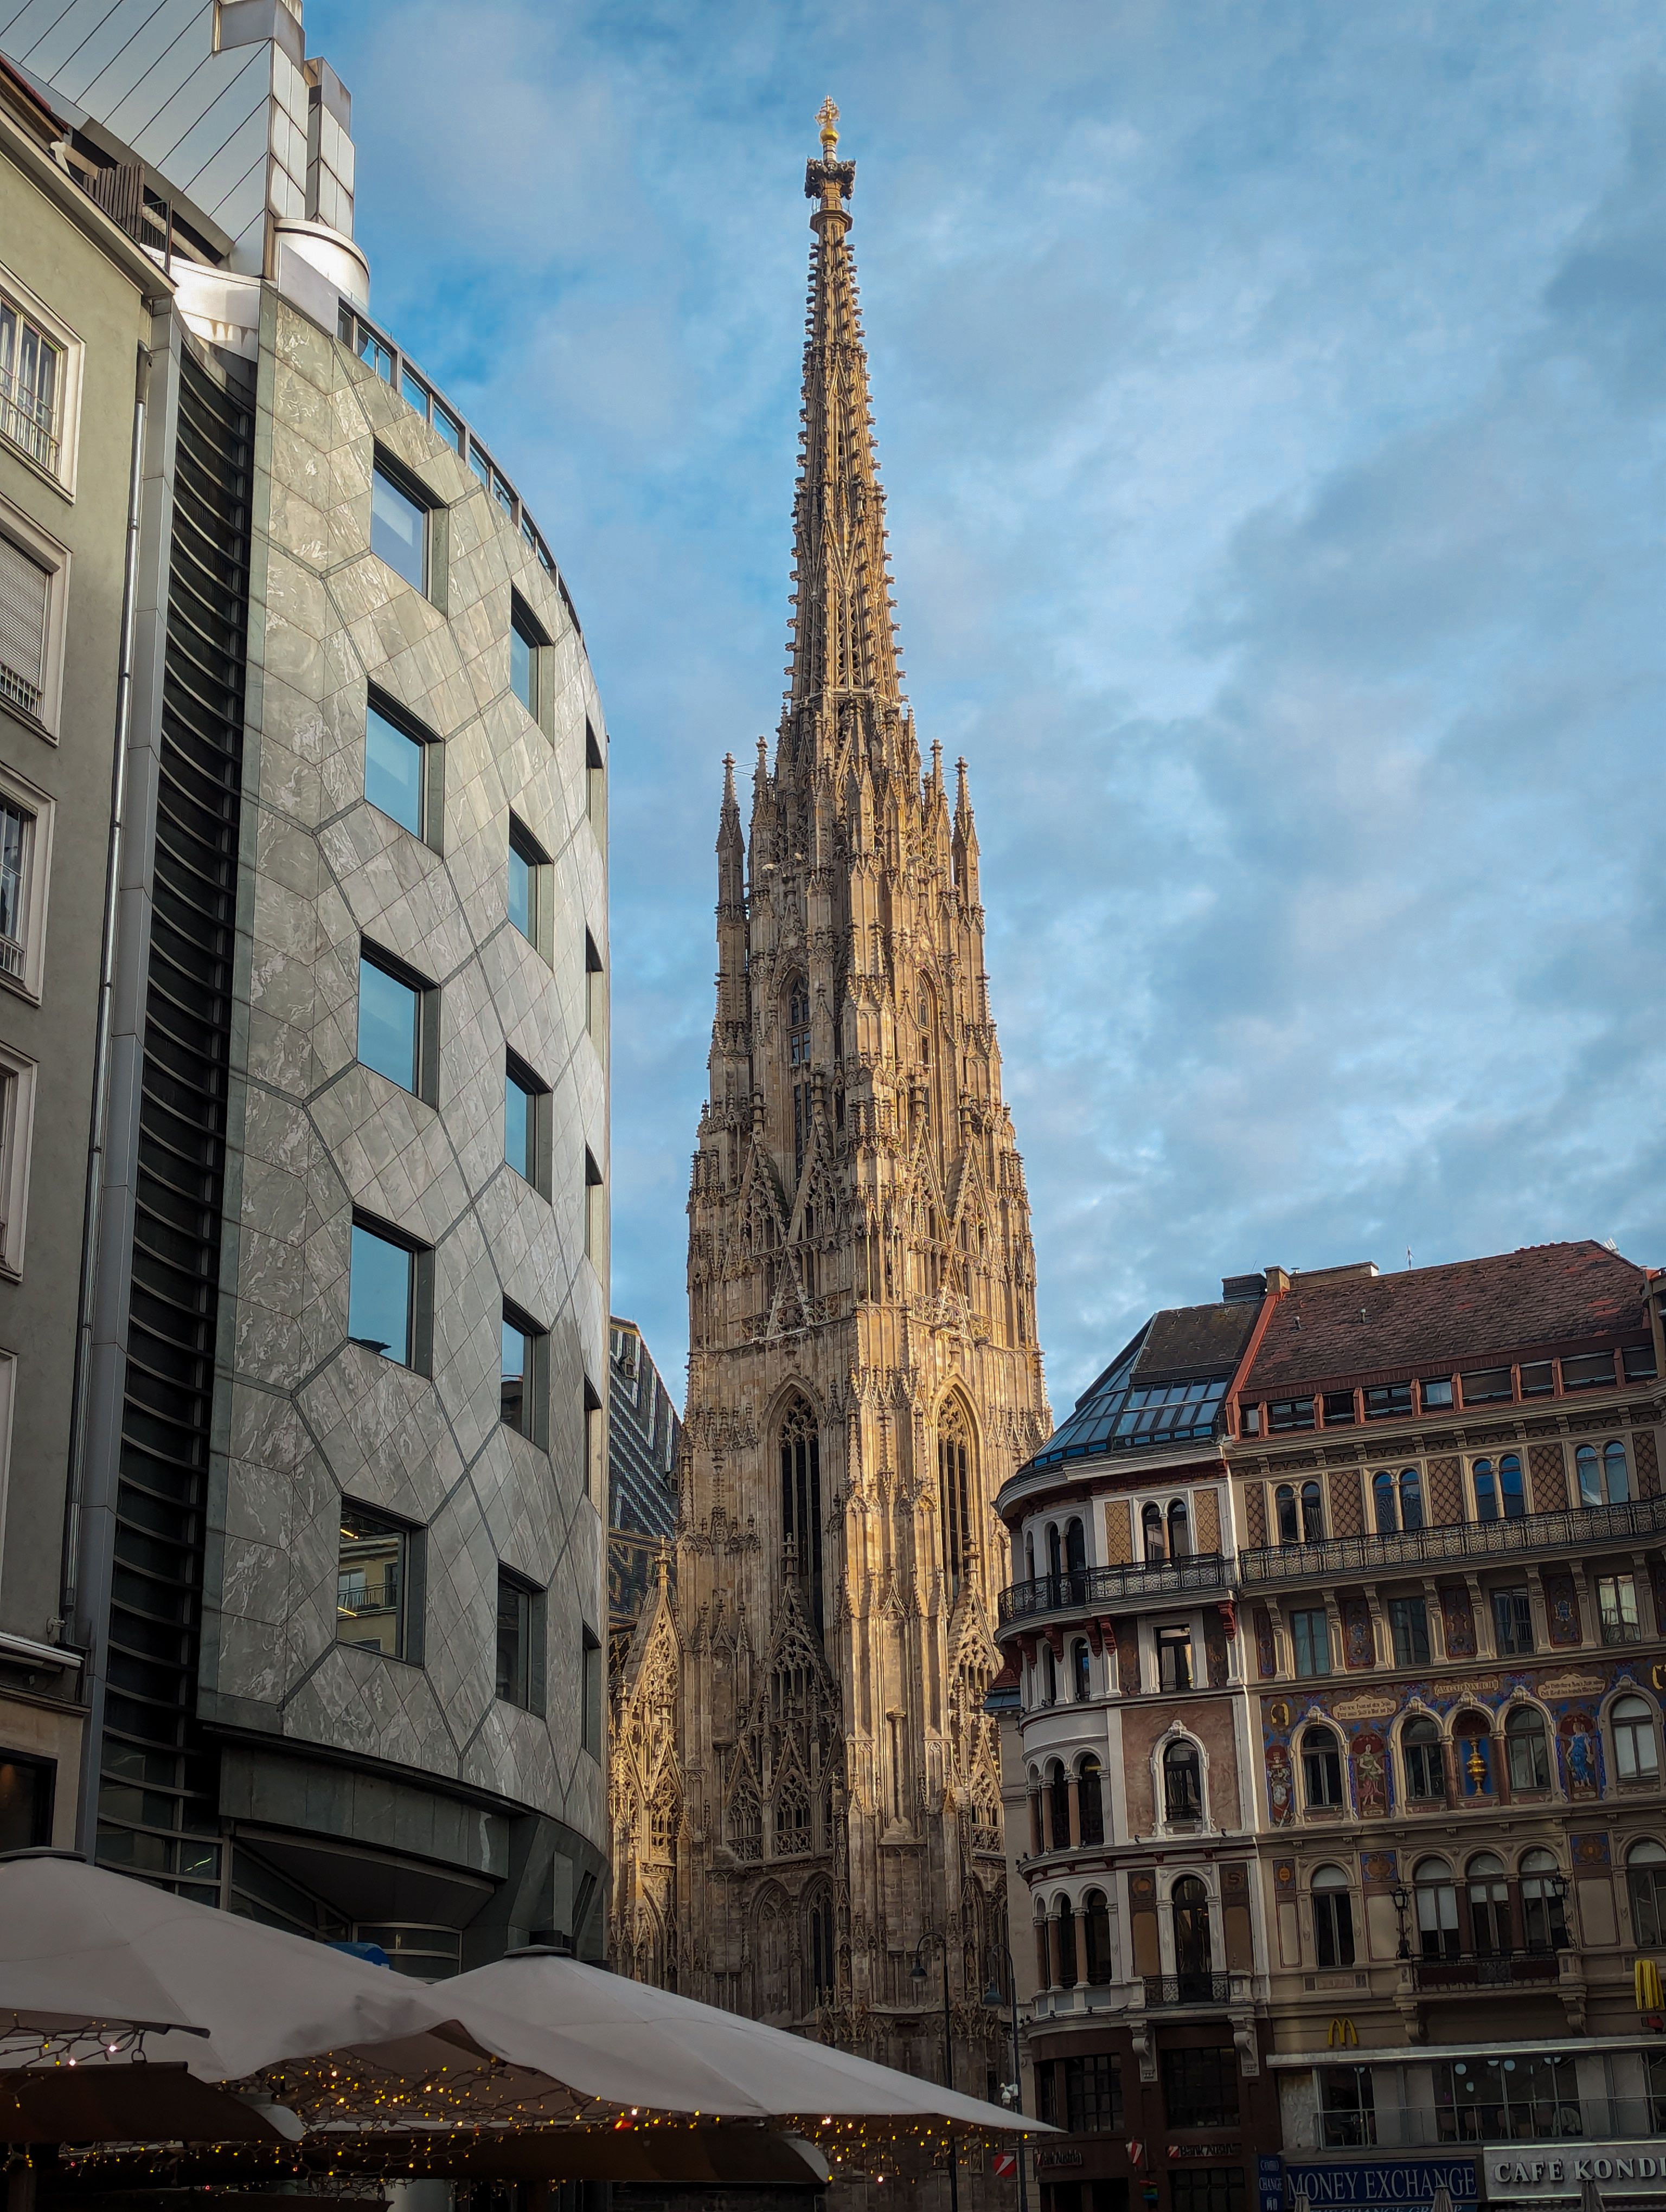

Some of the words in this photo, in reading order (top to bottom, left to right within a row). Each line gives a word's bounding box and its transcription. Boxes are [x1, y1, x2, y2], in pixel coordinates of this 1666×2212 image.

[1287, 2170, 1357, 2201] MONEY
[1364, 2167, 1477, 2198] EXCHANGE
[1494, 2158, 1565, 2182] CAFÉ
